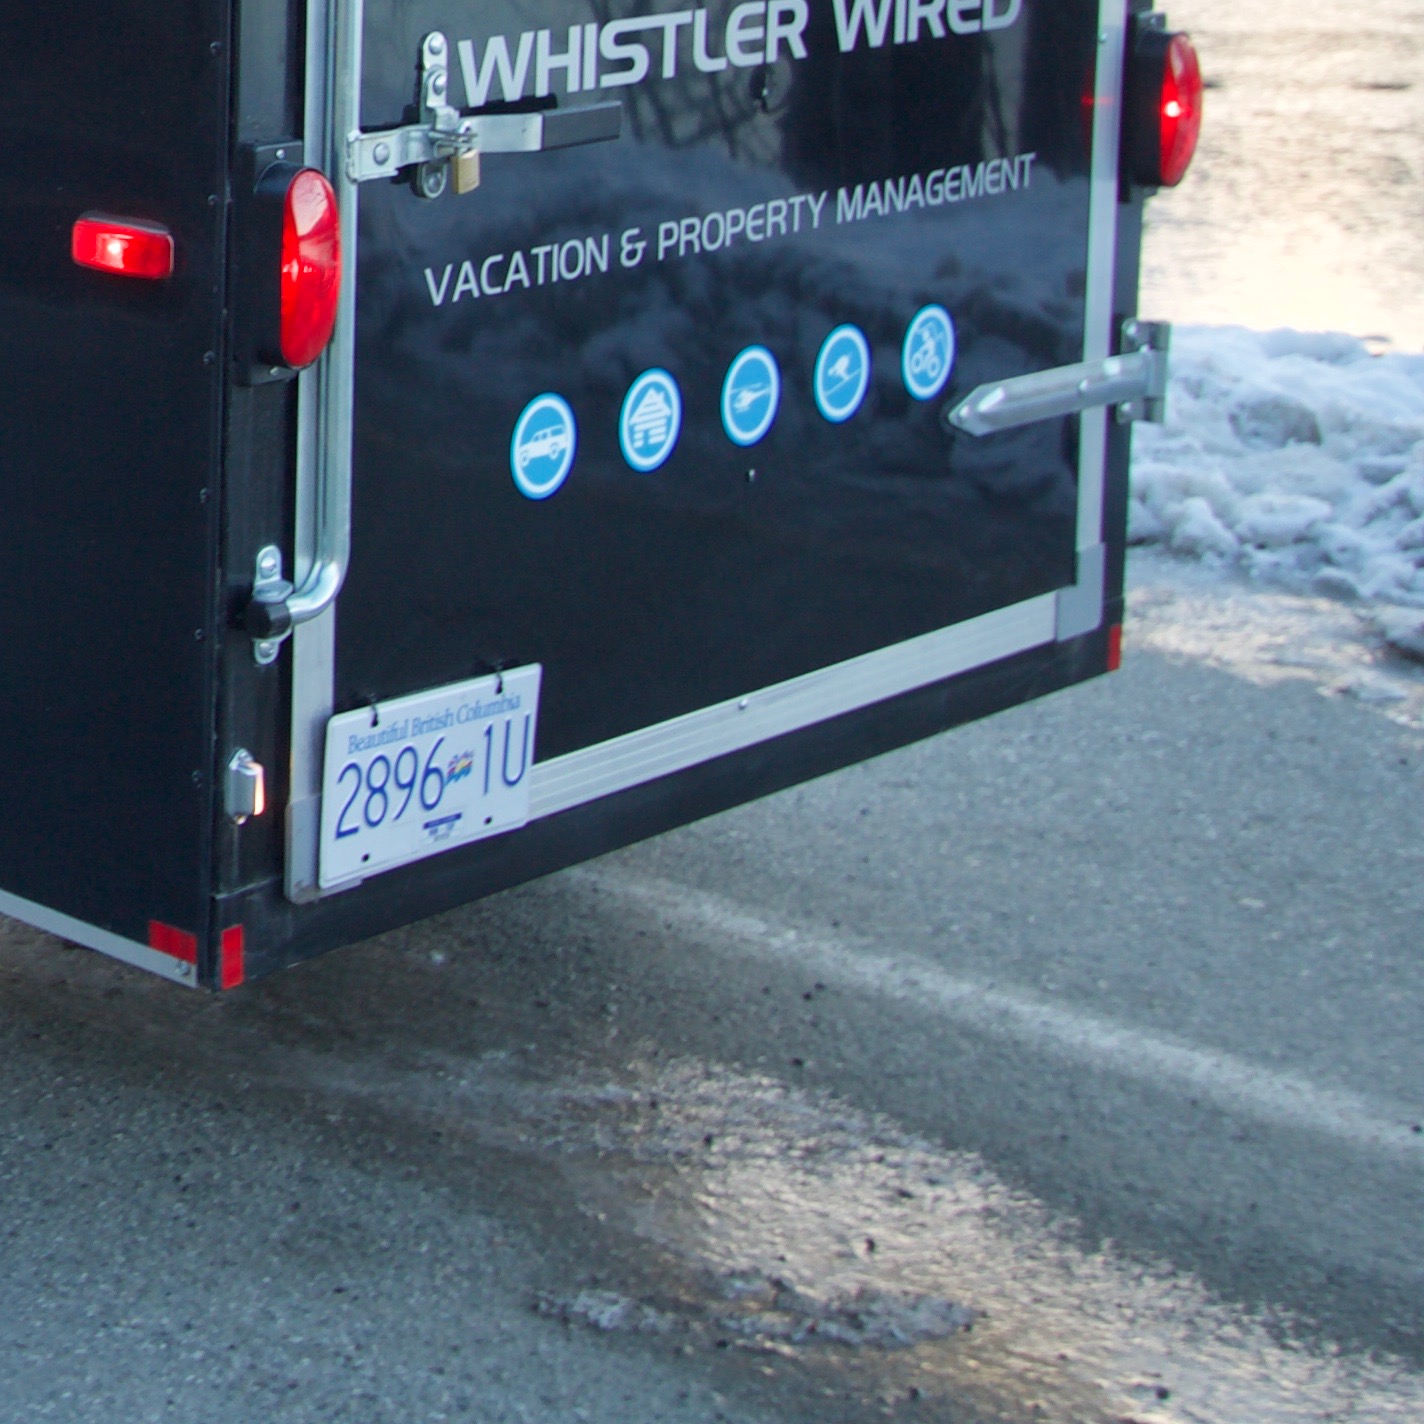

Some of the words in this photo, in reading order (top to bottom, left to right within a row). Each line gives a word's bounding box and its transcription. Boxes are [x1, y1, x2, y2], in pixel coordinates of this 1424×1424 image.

[424, 235, 610, 306] VACATION
[619, 227, 647, 267] &
[657, 192, 828, 261] PROPERTY
[836, 153, 1038, 224] MANAGEMENT
[335, 736, 446, 841] 2896
[483, 713, 532, 796] 1U
[348, 717, 409, 754] Beautiful
[411, 707, 455, 738] British
[456, 692, 521, 725] Columbia
